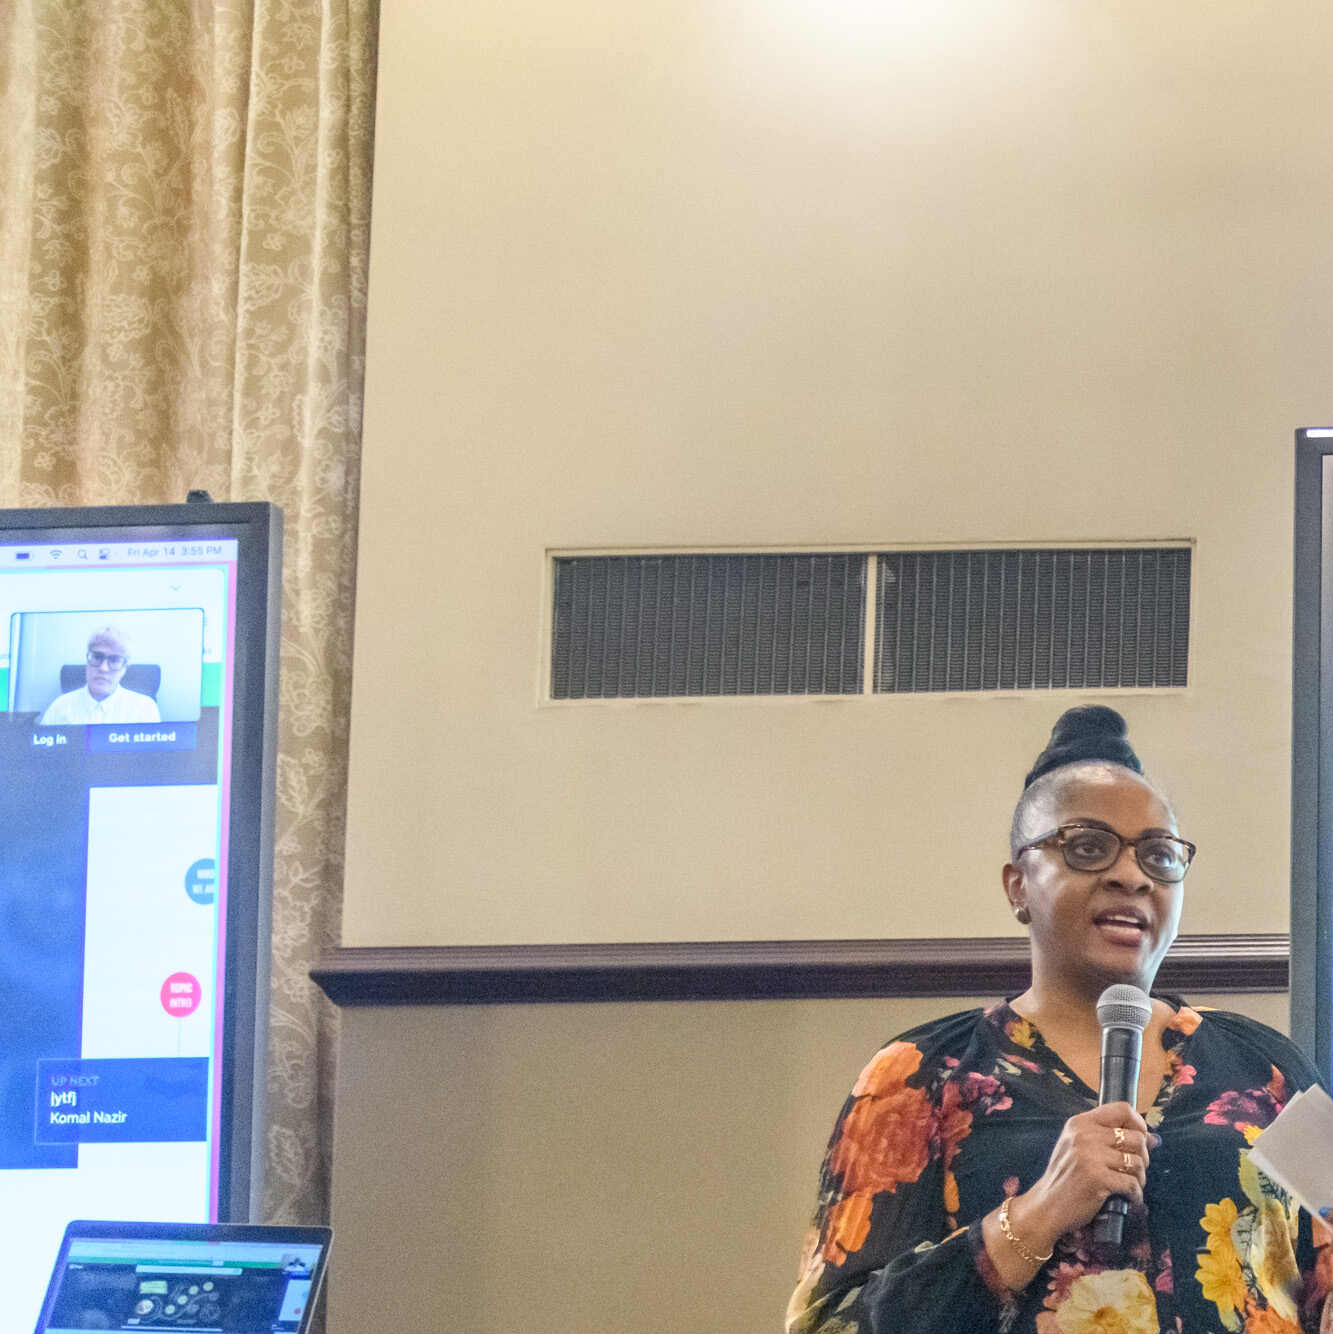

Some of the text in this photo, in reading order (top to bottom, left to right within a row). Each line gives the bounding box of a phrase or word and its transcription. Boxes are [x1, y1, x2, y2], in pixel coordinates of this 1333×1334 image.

[33, 733, 67, 746] Log in
[109, 731, 176, 743] Get started
[50, 1110, 128, 1124] Komal Nazir
